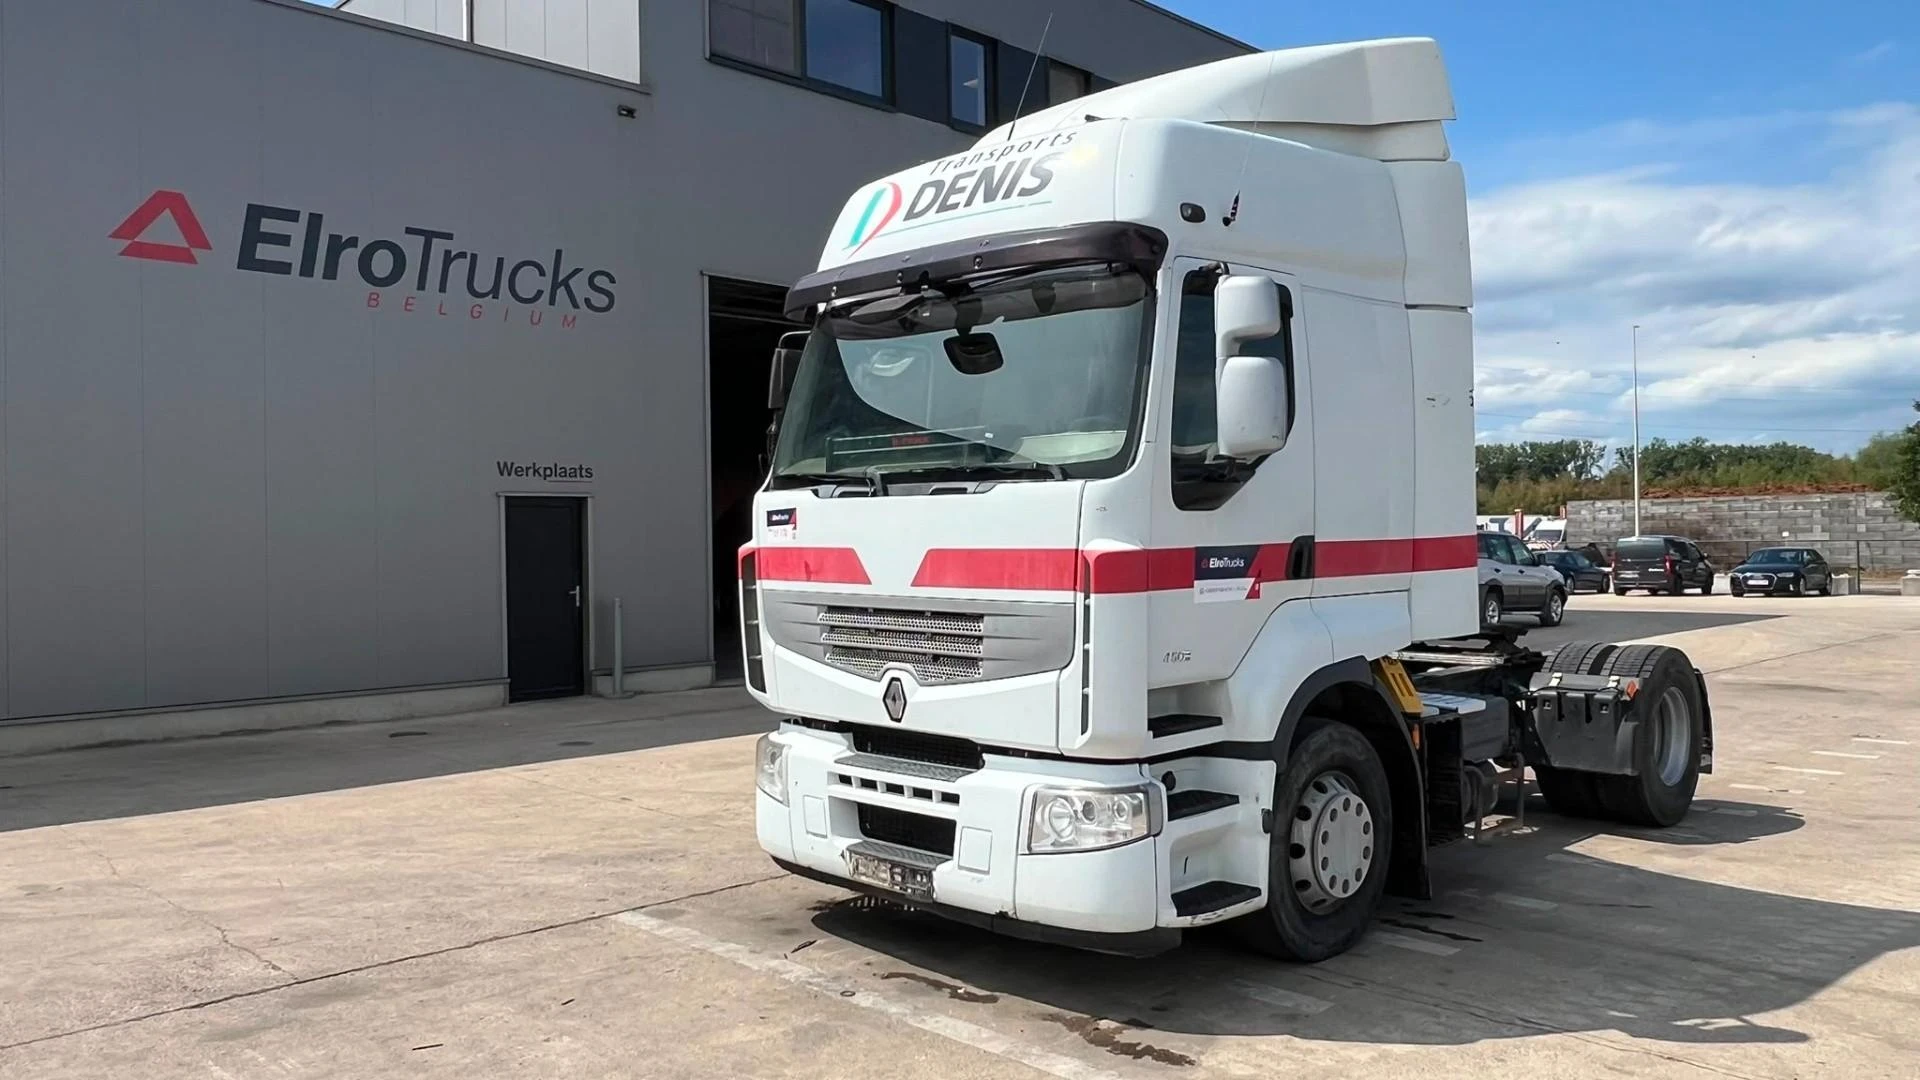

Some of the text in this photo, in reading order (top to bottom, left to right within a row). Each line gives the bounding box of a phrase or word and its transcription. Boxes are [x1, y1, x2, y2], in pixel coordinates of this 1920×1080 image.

[930, 132, 1077, 175] Transports
[903, 151, 1064, 222] DENIS
[236, 203, 617, 313] ElroTrucks
[366, 292, 577, 329] BELGIUM
[496, 460, 593, 480] Werkplaats
[1209, 557, 1245, 568] ElroTrucks
